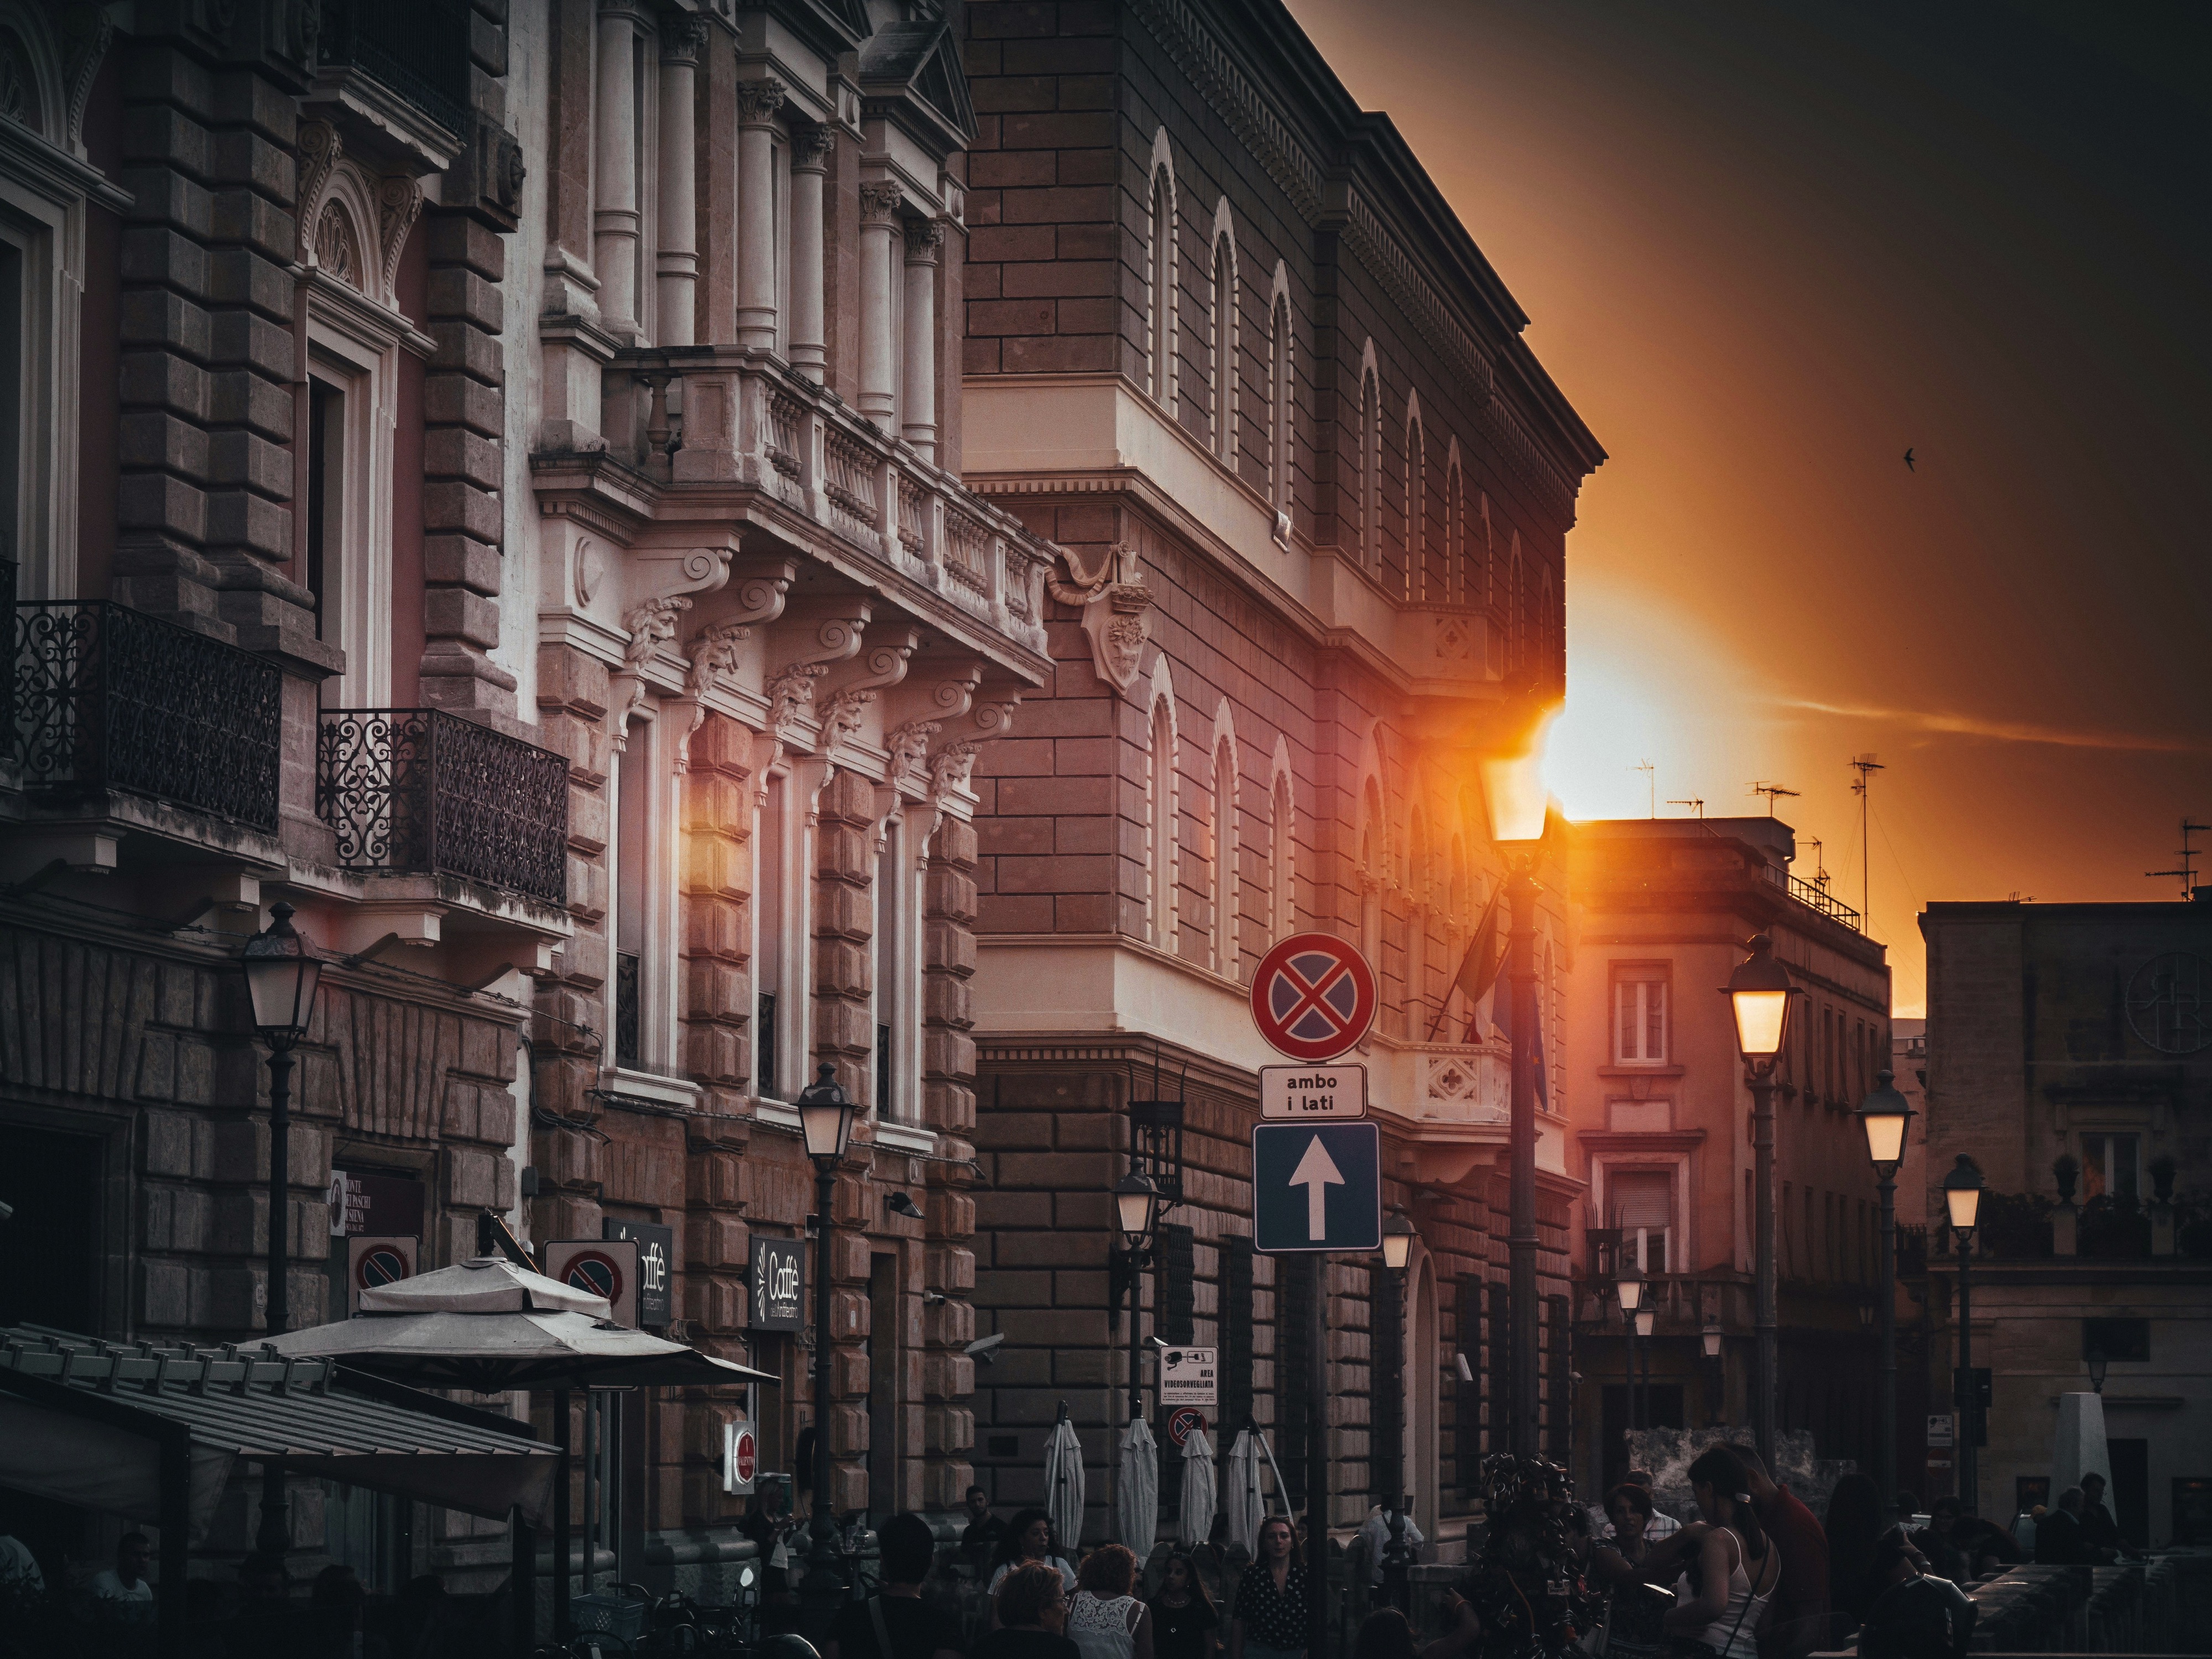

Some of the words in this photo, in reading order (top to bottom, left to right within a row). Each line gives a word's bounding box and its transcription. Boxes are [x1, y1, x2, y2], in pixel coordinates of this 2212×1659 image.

[1287, 1073, 1338, 1089] ambo
[1287, 1096, 1292, 1111] i
[1302, 1095, 1333, 1111] lati
[353, 1195, 371, 1209] PASCHI
[349, 1209, 364, 1223] SIENA
[642, 1242, 665, 1292] affè
[769, 1251, 799, 1301] Caffè
[1200, 1369, 1214, 1378] AREA
[1164, 1380, 1214, 1389] VIDEOSORVEGLIATA
